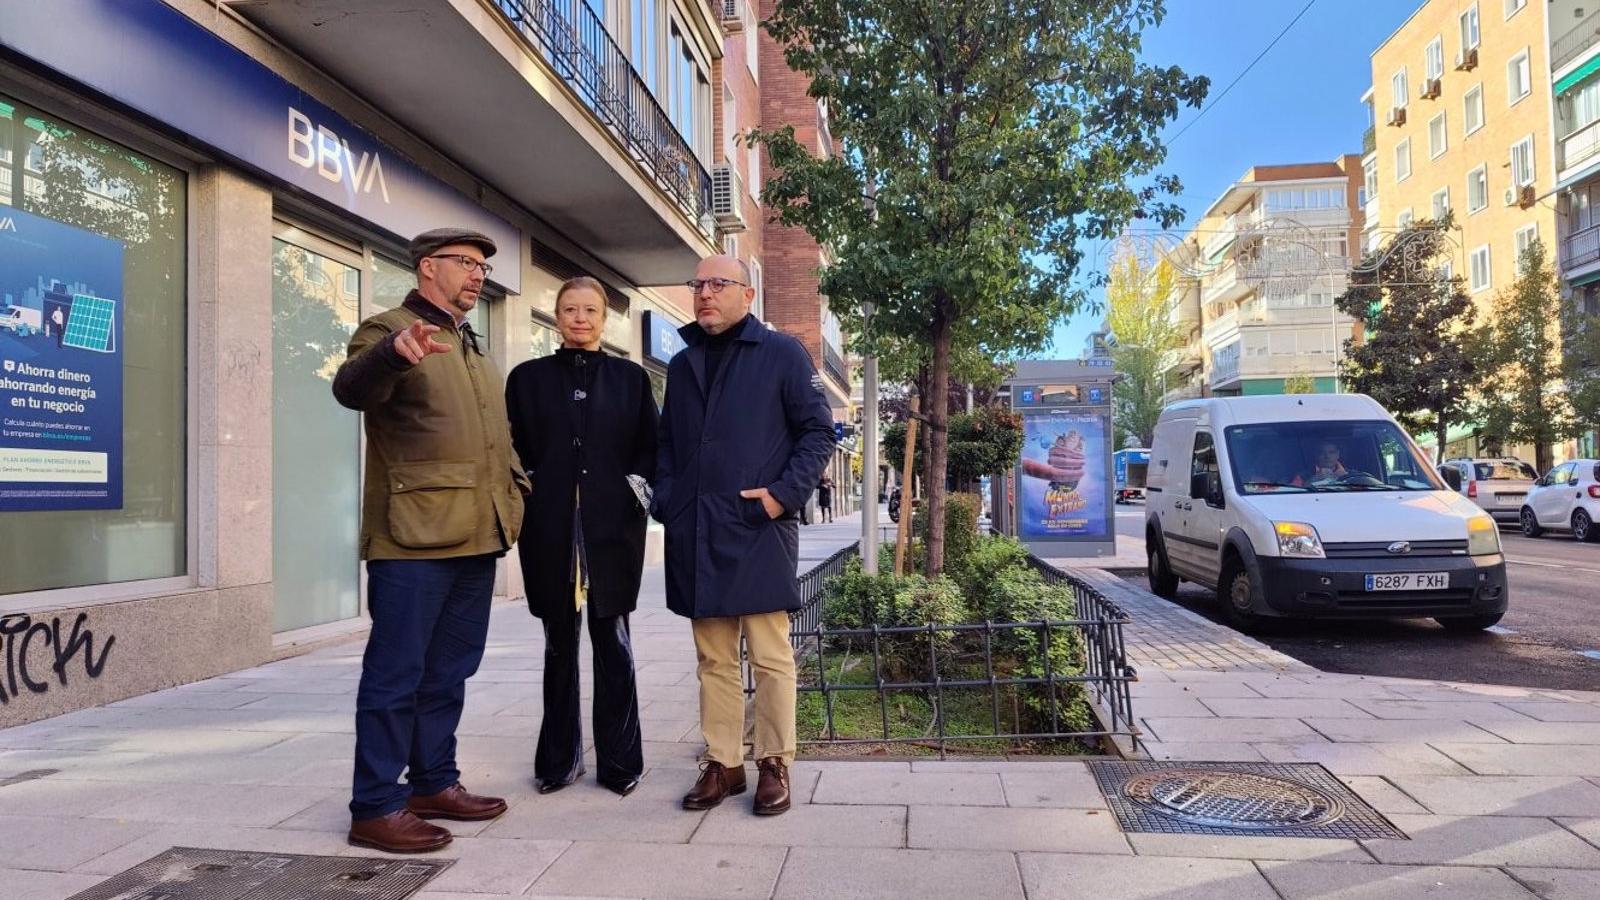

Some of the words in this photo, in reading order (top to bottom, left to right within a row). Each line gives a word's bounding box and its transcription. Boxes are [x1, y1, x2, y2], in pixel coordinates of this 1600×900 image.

[288, 106, 391, 205] BBVA
[17, 362, 55, 378] Ahorra
[57, 368, 91, 383] dinero
[0, 377, 56, 394] ahorrando
[58, 387, 96, 401] energía
[11, 397, 26, 407] en
[28, 396, 40, 408] tu
[43, 400, 85, 413] negocio
[1375, 575, 1410, 589] 6287
[1416, 574, 1445, 588] FXH
